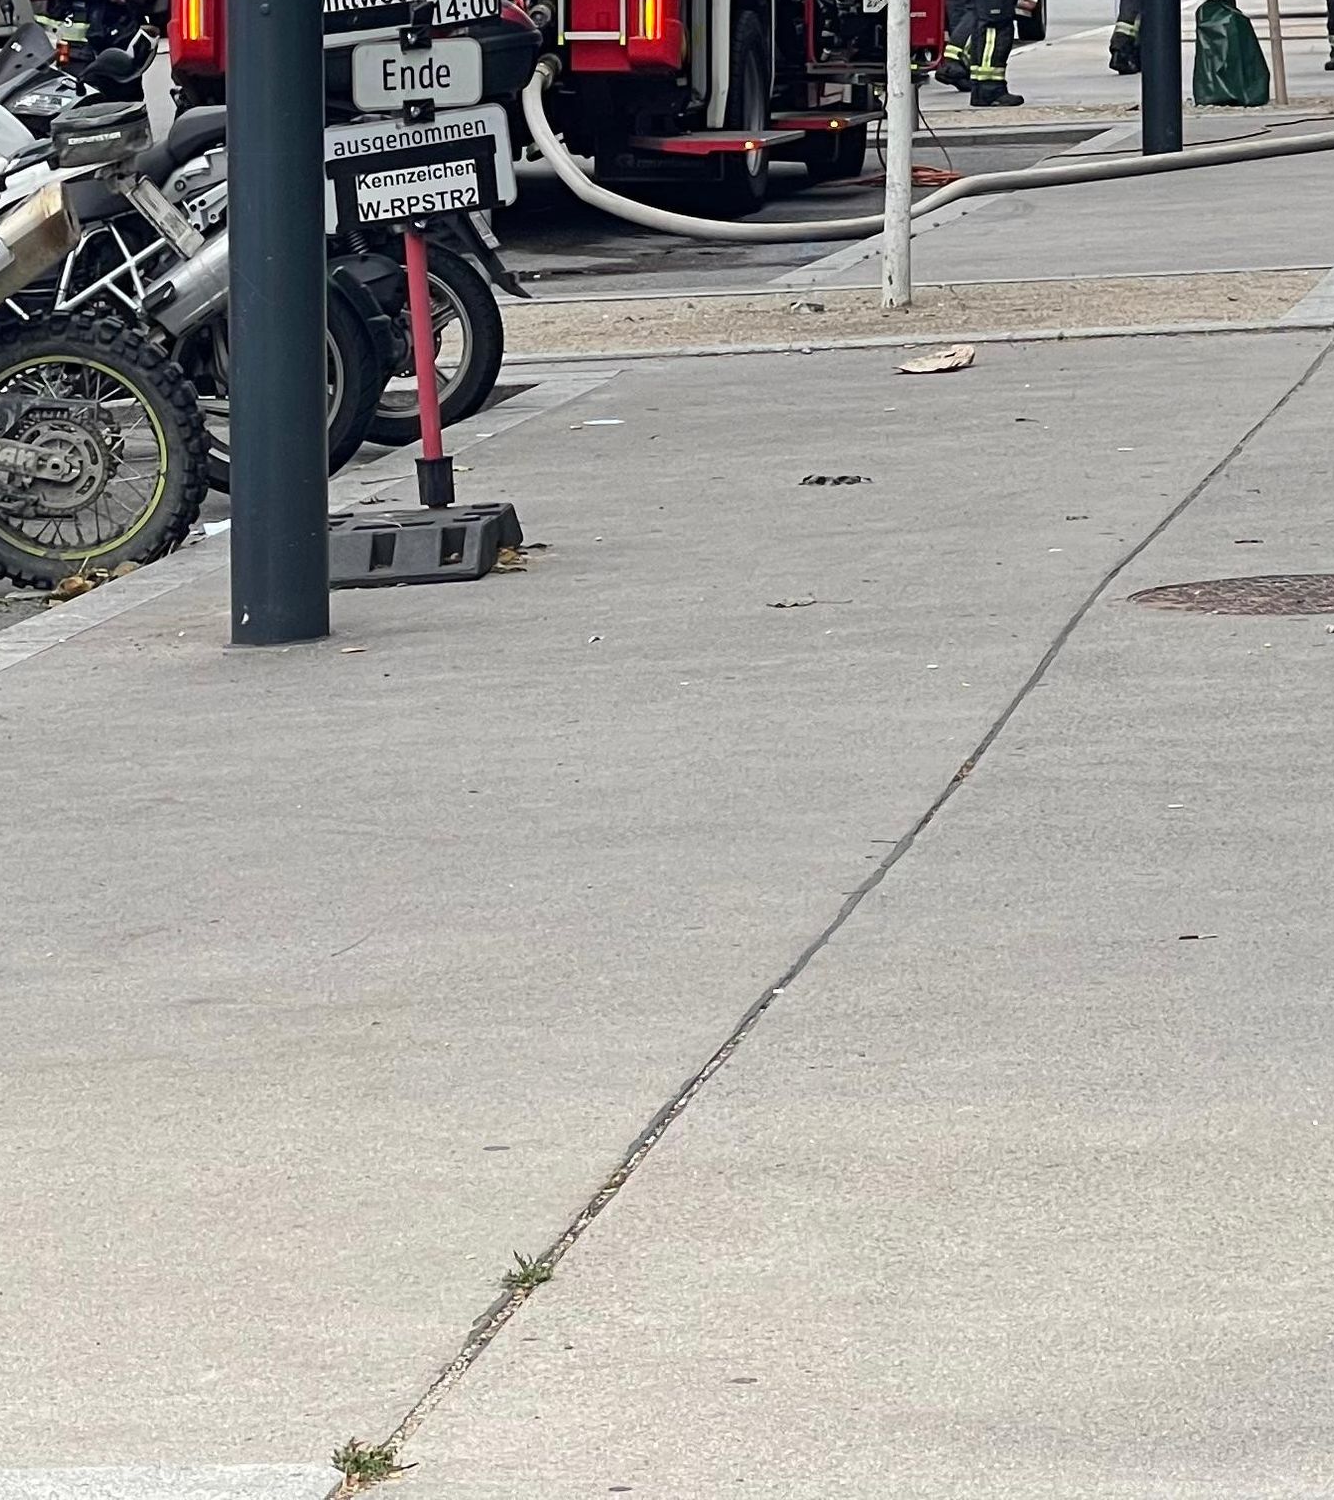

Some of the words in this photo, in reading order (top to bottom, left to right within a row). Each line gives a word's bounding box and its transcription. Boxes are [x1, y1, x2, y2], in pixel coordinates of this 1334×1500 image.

[383, 57, 451, 92] Ende
[333, 119, 487, 157] ausgenommen
[357, 161, 477, 190] Kennzeichen
[359, 187, 478, 220] W-RPSTR2
